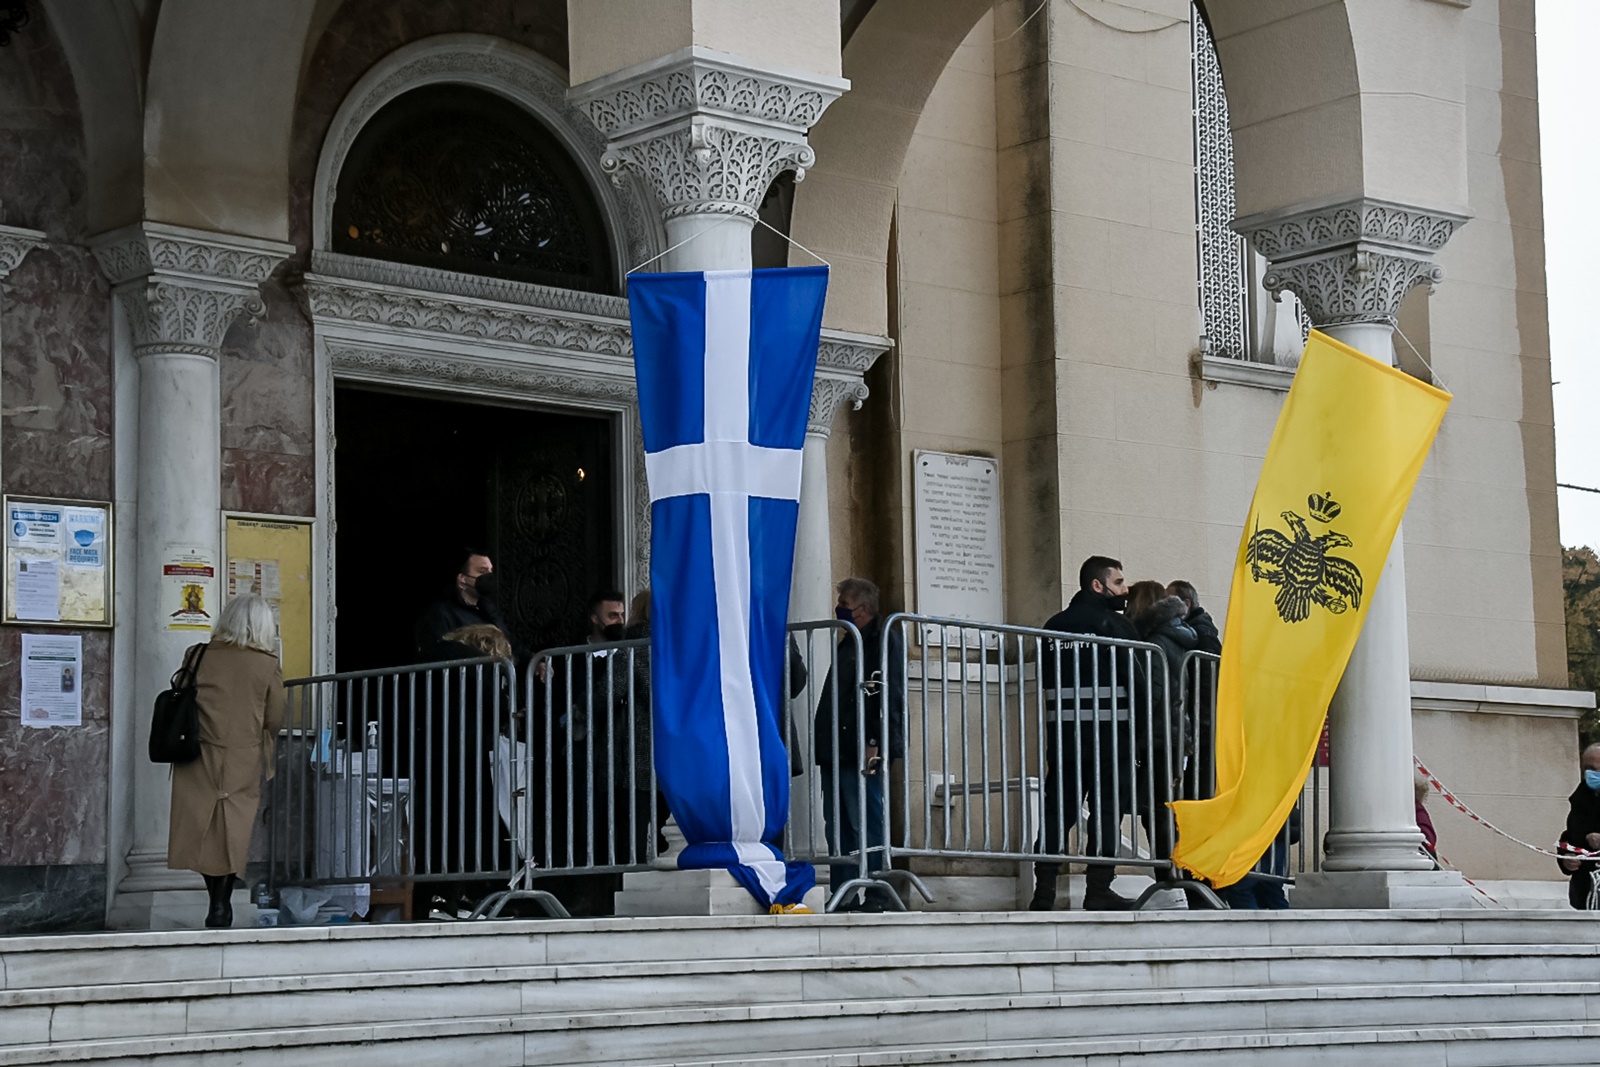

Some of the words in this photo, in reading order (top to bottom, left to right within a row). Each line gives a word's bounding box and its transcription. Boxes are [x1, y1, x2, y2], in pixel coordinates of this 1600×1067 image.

[68, 514, 100, 524] WARNING
[70, 548, 83, 556] FACE
[70, 555, 99, 563] REQUIRED
